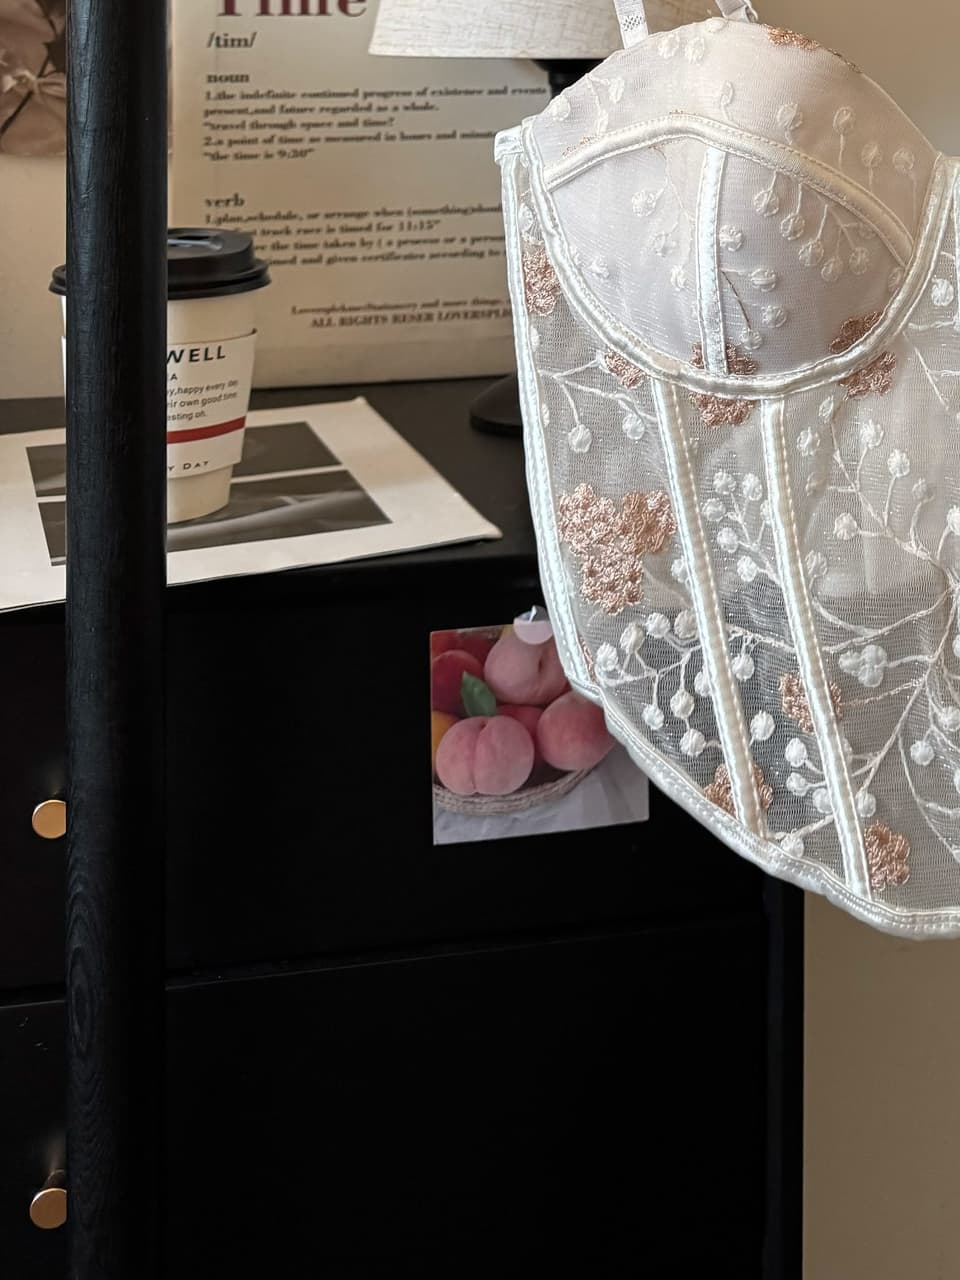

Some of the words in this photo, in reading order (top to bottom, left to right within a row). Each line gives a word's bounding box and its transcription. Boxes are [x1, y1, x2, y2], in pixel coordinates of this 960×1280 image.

[206, 73, 250, 84] noun
[415, 86, 429, 97] of
[487, 85, 508, 96] and
[337, 118, 359, 128] and
[262, 134, 276, 145] of
[278, 134, 304, 144] time
[435, 129, 457, 140] and
[232, 150, 261, 161] time
[205, 192, 245, 208] verb
[179, 398, 200, 407] own
[201, 395, 222, 407] good
[183, 460, 210, 471] DAY
